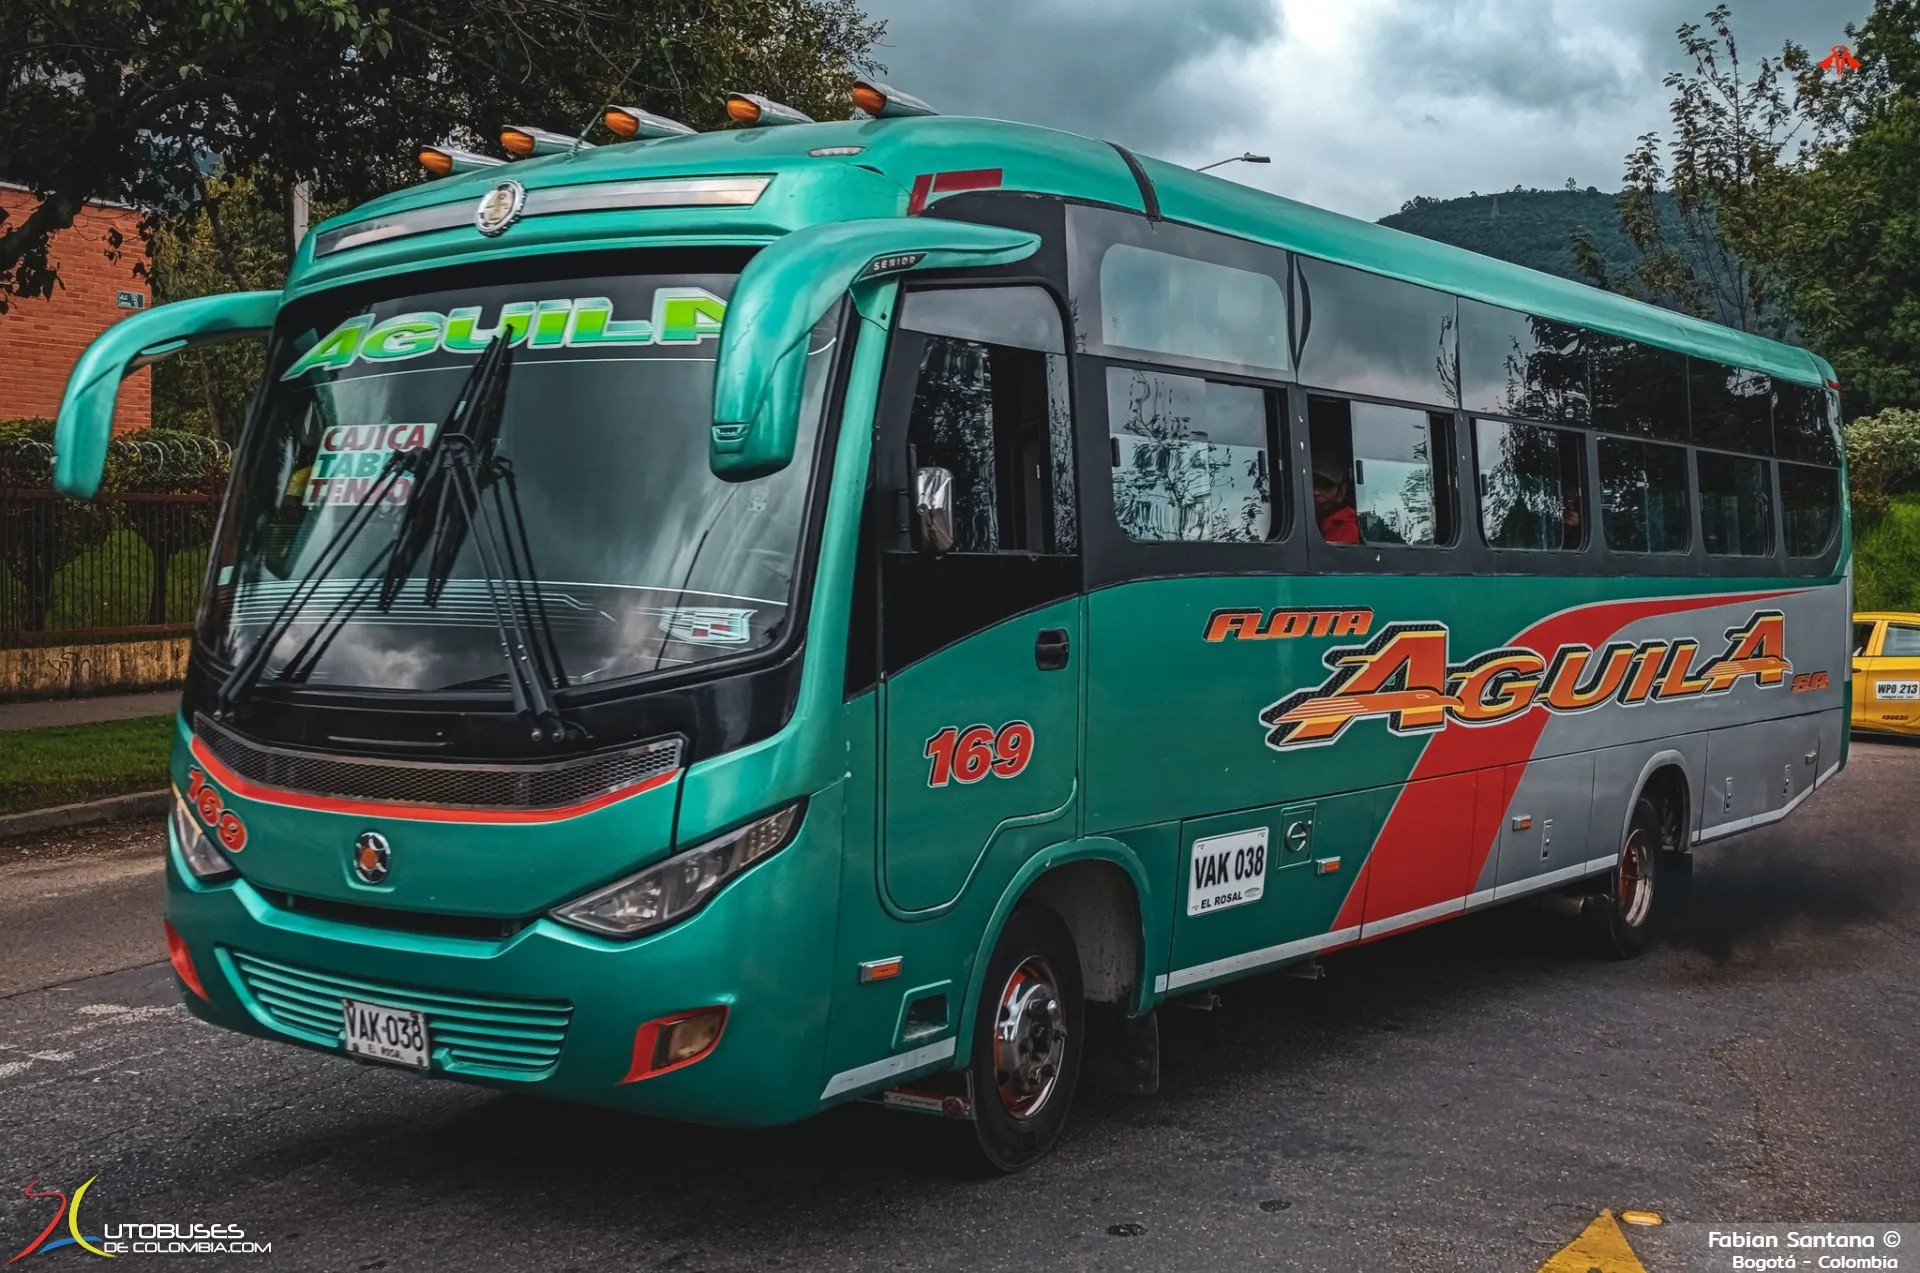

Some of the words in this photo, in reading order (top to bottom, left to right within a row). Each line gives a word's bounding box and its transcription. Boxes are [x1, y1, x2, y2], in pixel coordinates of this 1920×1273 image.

[873, 256, 916, 270] SENIOR
[279, 286, 728, 382] AGUILA
[323, 424, 426, 452] CAJICA
[317, 452, 412, 478] TAB
[1202, 605, 1375, 643] FLOTA
[1260, 610, 1793, 751] AGUILA
[1899, 684, 1918, 694] 213
[923, 719, 1035, 788] 169
[187, 764, 248, 853] 169
[1194, 851, 1231, 890] VAK
[1234, 845, 1265, 881] 038
[1201, 899, 1212, 909] EL
[1214, 890, 1243, 906] ROSAL
